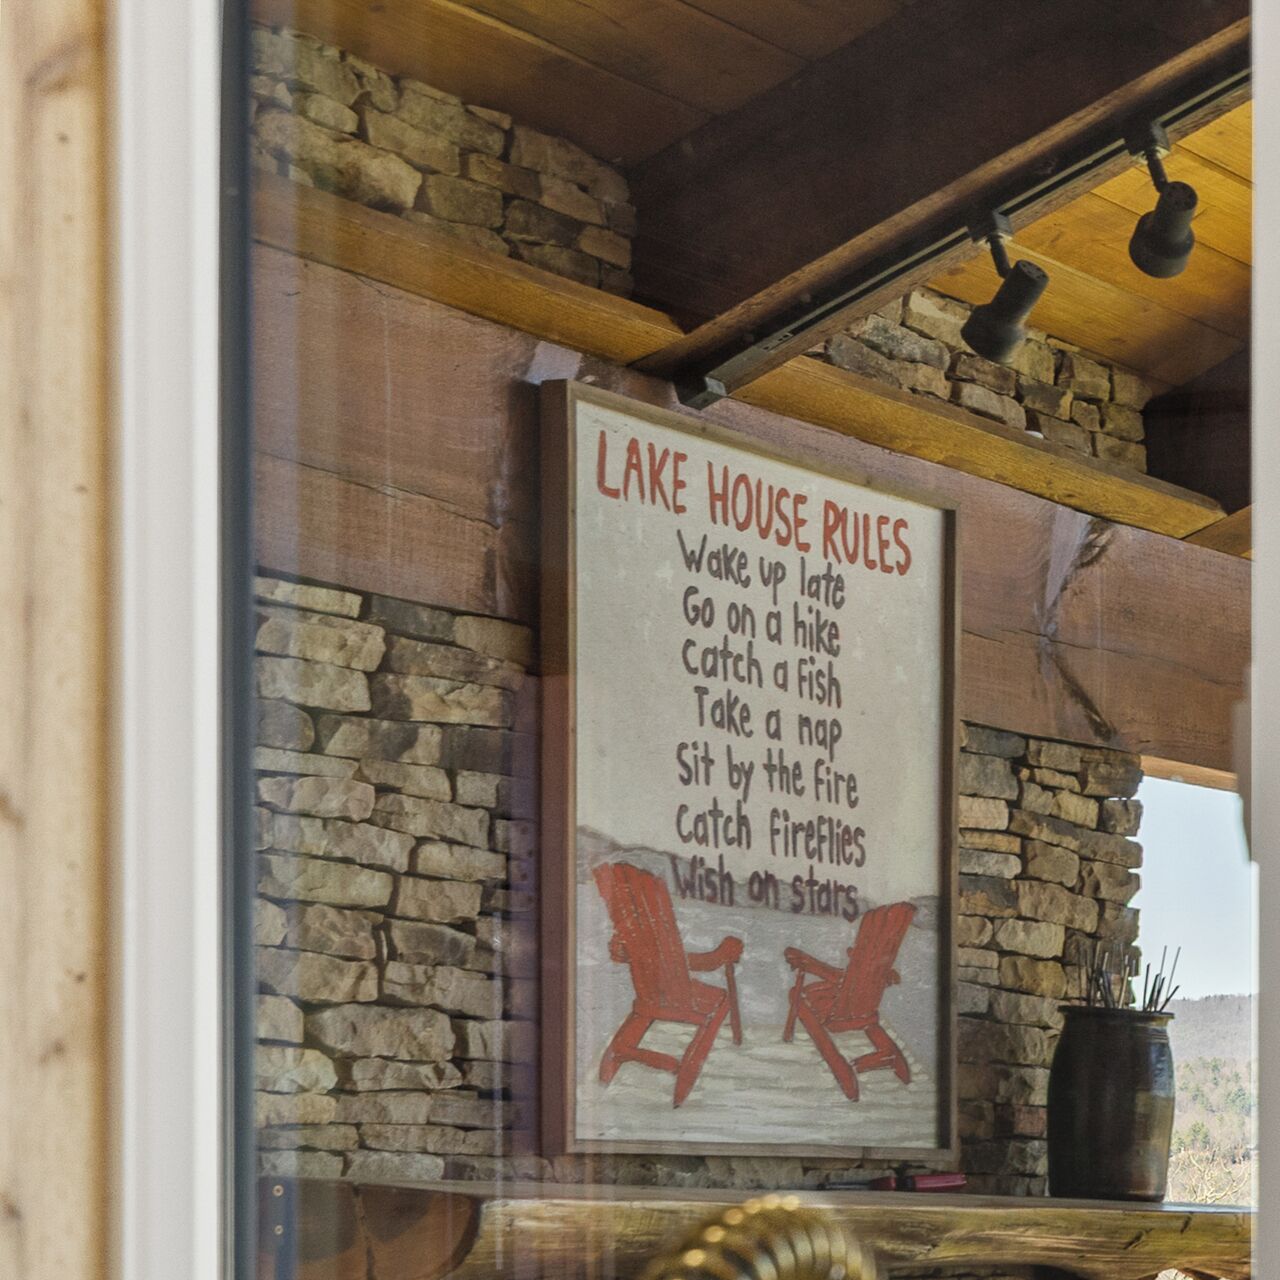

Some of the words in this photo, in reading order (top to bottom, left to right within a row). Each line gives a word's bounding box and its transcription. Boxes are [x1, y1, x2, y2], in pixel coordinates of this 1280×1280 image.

[596, 430, 688, 514] LAKE
[706, 460, 811, 553] HOUSE
[822, 499, 912, 576] RULES
[676, 529, 752, 588] Wake
[759, 556, 786, 606] up
[800, 556, 846, 610] late
[683, 585, 715, 629] Go
[727, 602, 756, 639] on
[765, 610, 782, 645] a
[793, 601, 841, 657] hike
[682, 634, 763, 688] Catch
[773, 660, 788, 692] a
[694, 685, 754, 738] Take
[765, 709, 782, 741] a
[798, 714, 842, 763] nap
[676, 741, 715, 786] Sit
[726, 744, 755, 804] by
[762, 747, 805, 797] the
[676, 796, 752, 850] Catch
[769, 807, 866, 868] fireflies
[670, 853, 735, 907] Wish
[748, 869, 780, 910] on
[791, 864, 860, 923] stars
